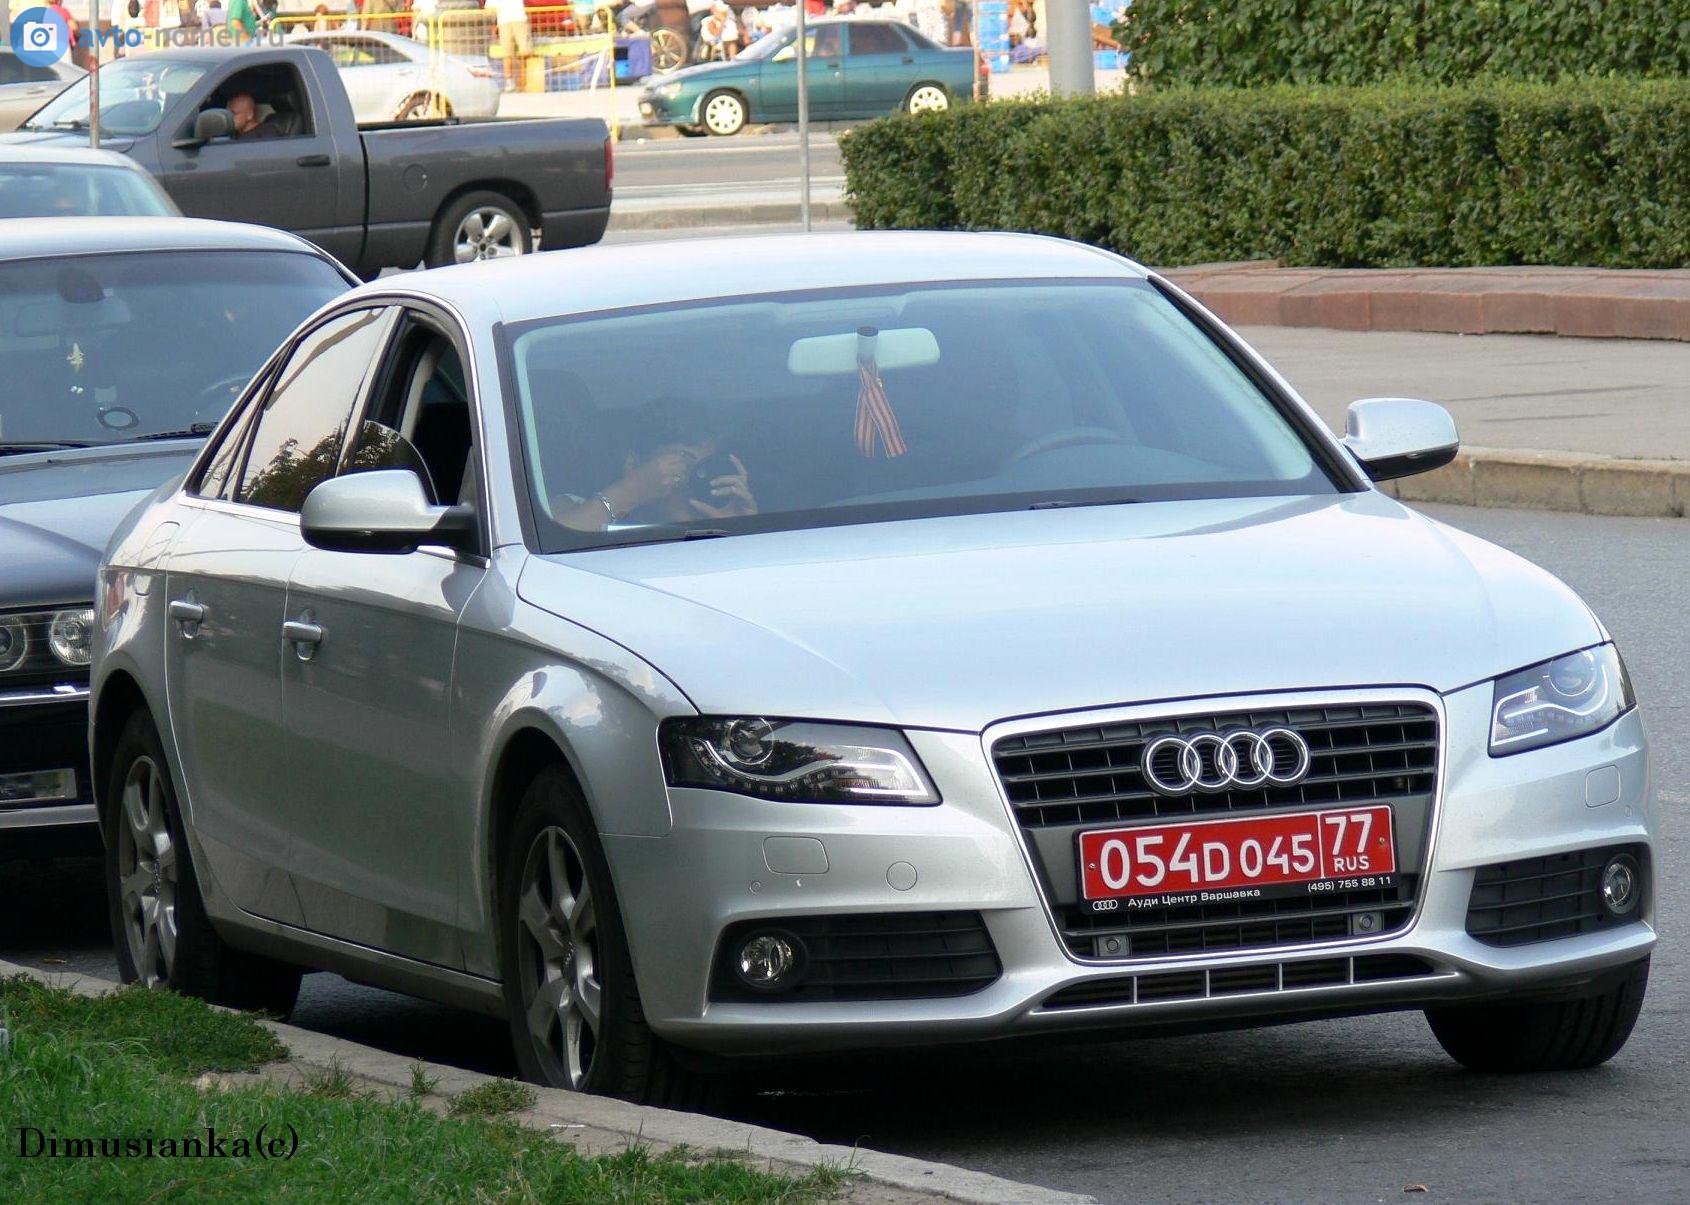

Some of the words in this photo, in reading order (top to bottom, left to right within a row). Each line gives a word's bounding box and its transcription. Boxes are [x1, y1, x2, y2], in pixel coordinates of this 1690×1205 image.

[1325, 813, 1373, 855] 77
[1333, 856, 1370, 873] RUS
[1307, 881, 1335, 893] (495)
[1337, 879, 1359, 889] 755
[1361, 877, 1376, 887] 88
[1378, 876, 1391, 885] 11
[1127, 897, 1159, 908] Ауди
[1161, 893, 1198, 906] Центр
[1200, 888, 1261, 902] Варшавка
